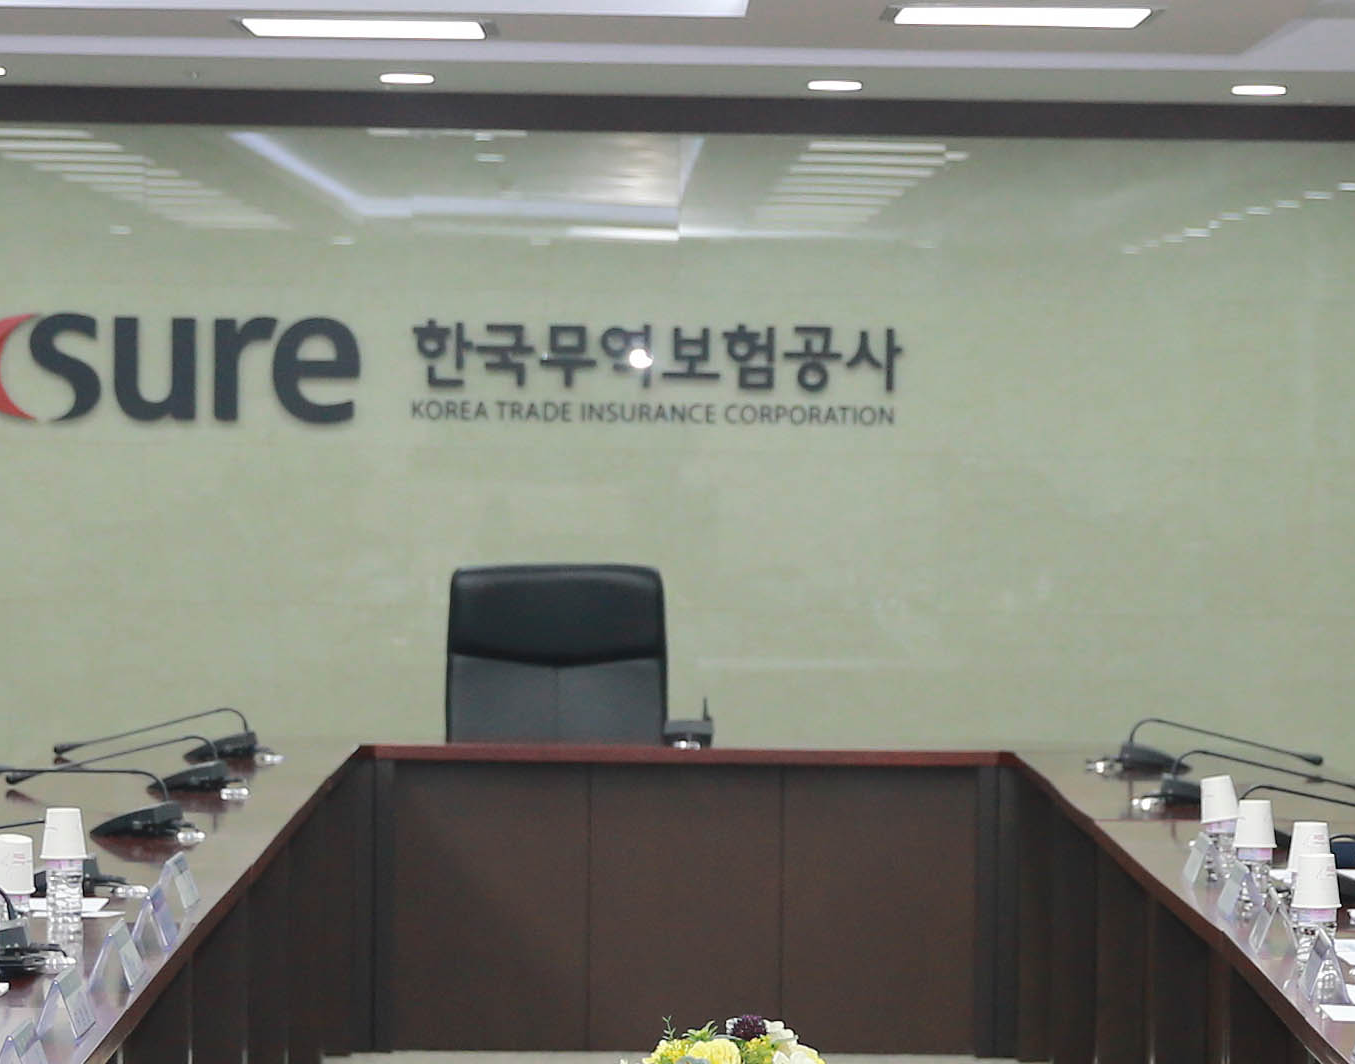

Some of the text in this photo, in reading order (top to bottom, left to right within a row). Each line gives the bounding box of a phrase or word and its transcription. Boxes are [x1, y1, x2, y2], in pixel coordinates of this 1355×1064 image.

[412, 319, 903, 392] 한국무역보험공사
[411, 400, 894, 426] KOREA TRADE INSURANCE CORPORATION
